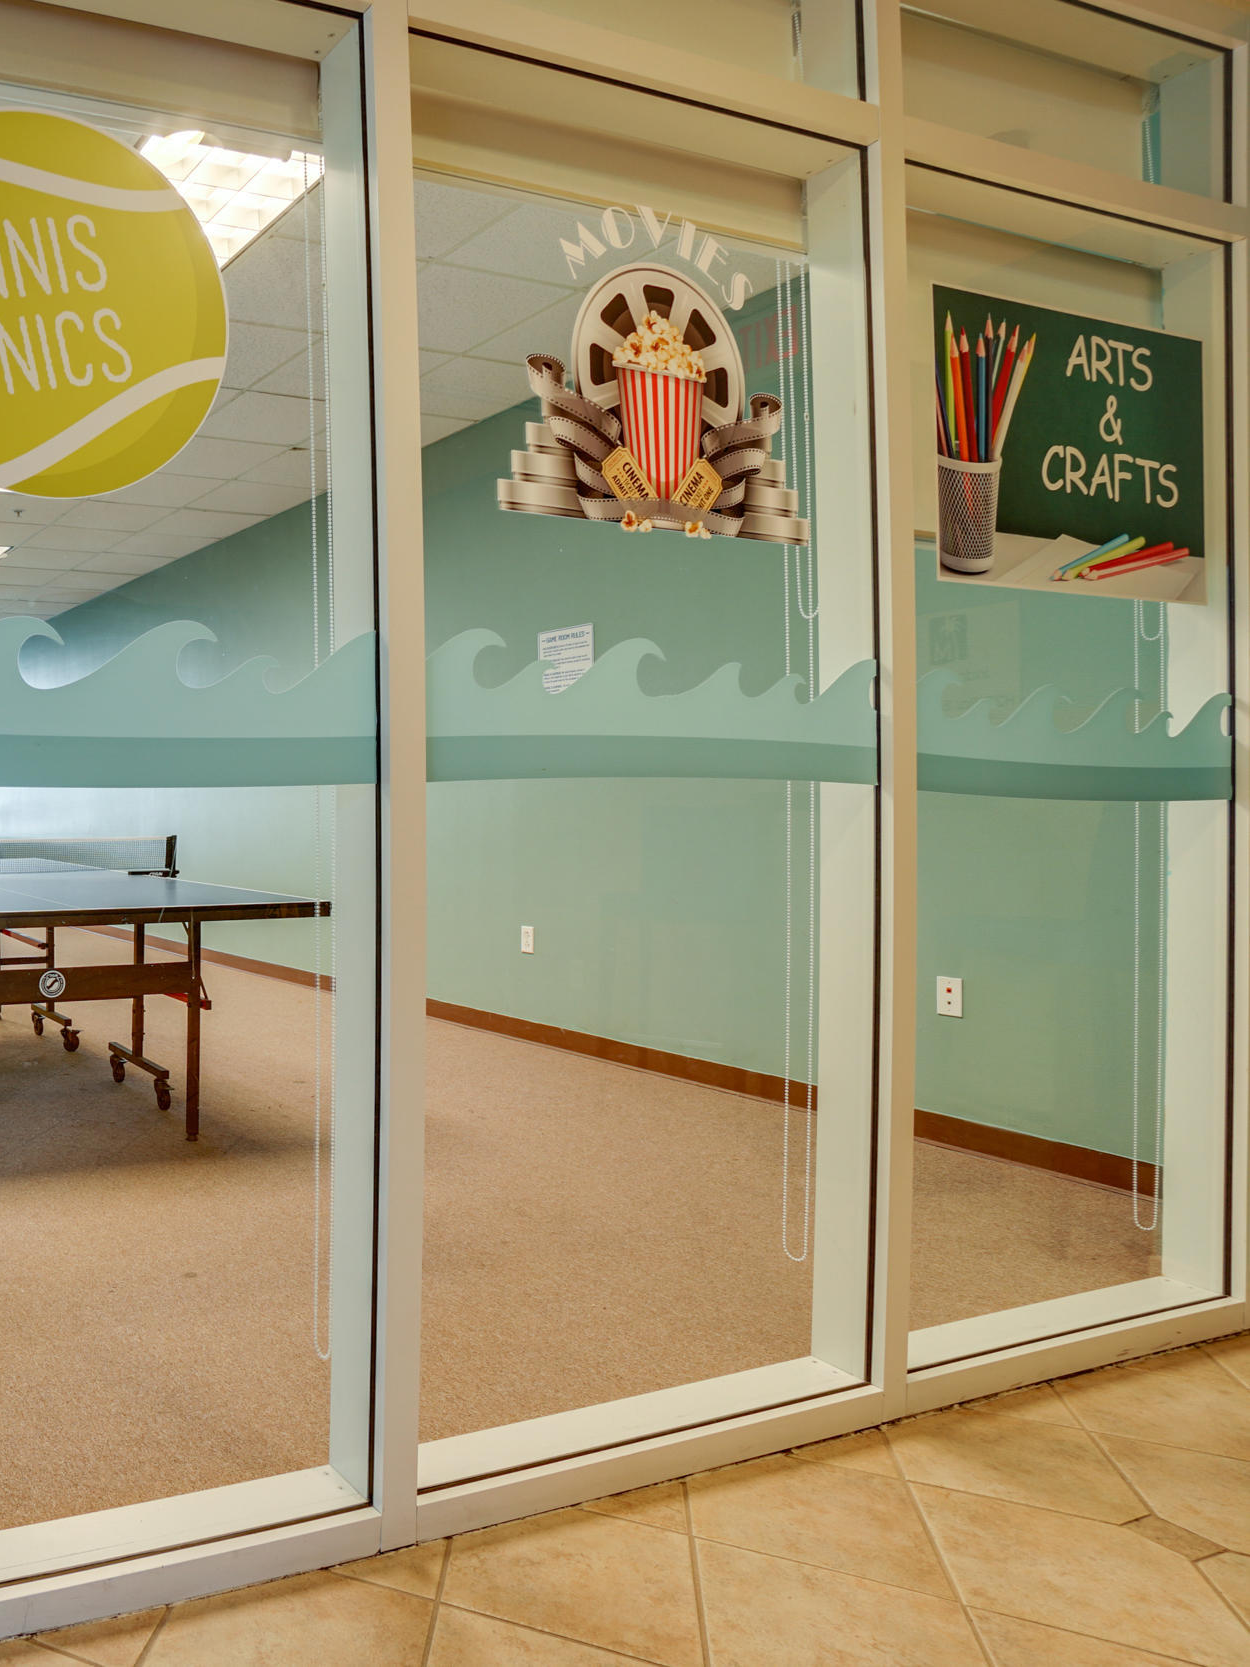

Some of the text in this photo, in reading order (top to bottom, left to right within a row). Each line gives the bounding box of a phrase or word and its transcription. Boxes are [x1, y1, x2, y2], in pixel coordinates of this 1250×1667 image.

[559, 205, 753, 310] MOVIES
[1066, 335, 1153, 391] ARTS
[1099, 395, 1123, 445] &
[612, 474, 629, 497] ADMIT
[623, 462, 650, 500] CINEMA
[679, 471, 704, 506] CINEMA
[1041, 445, 1178, 508] CRAFTS
